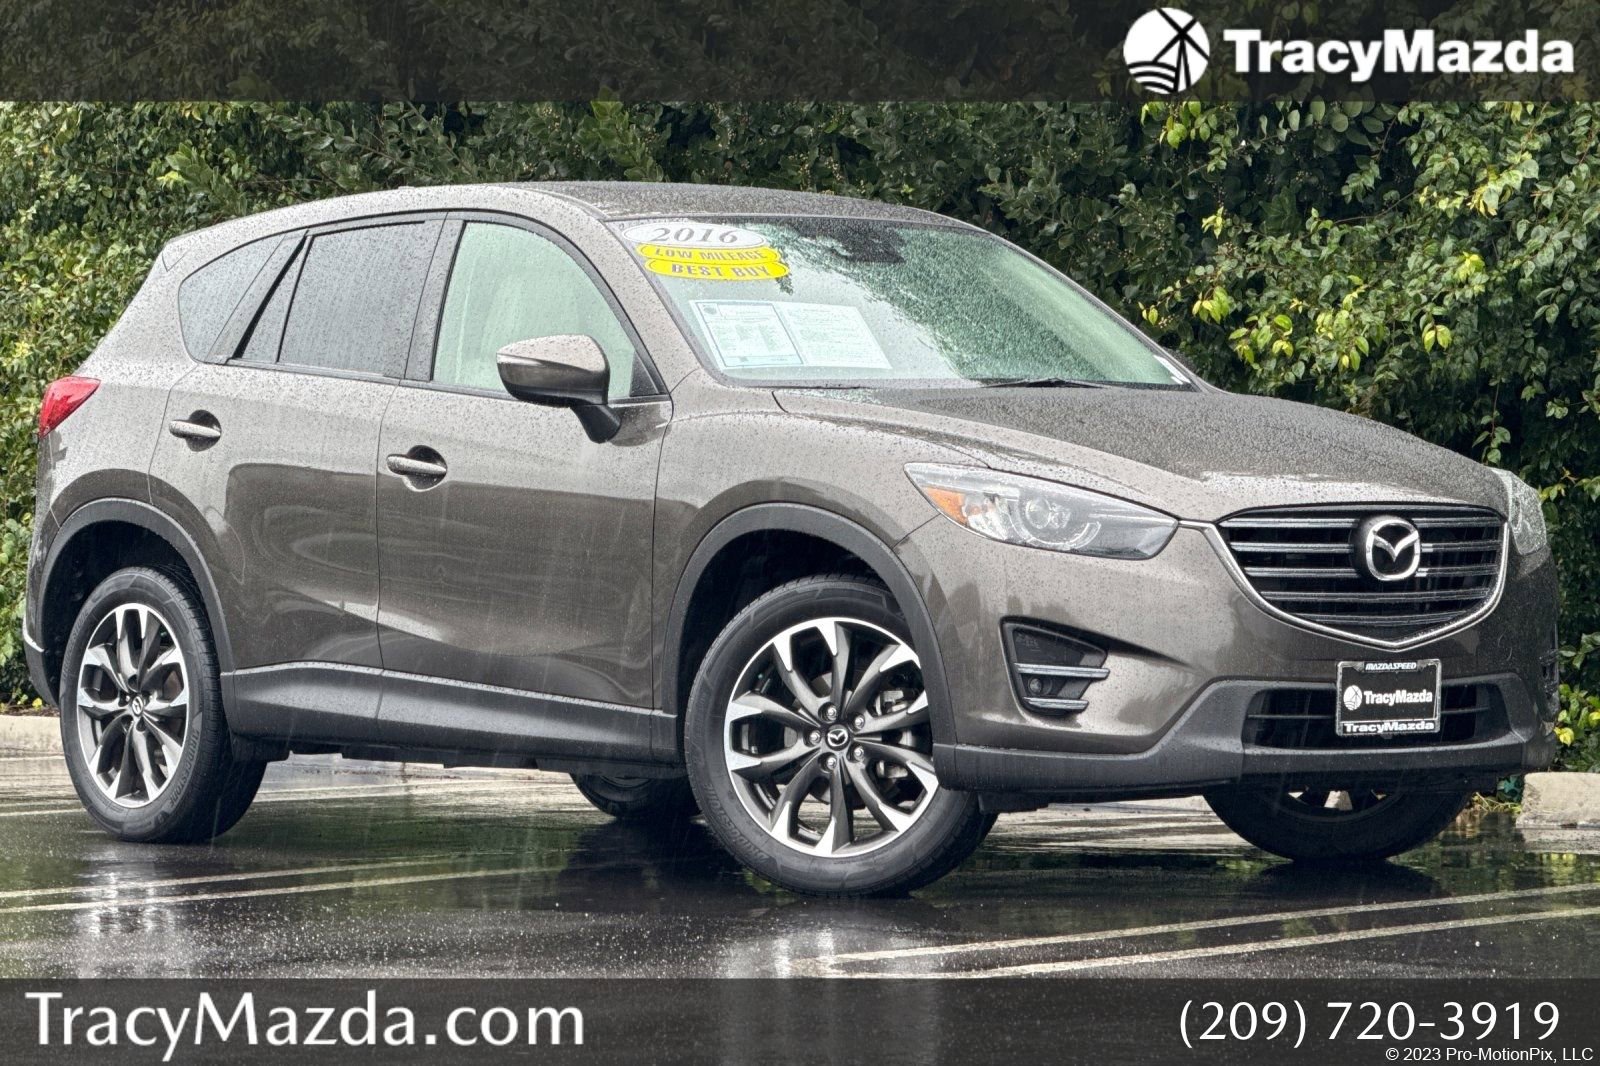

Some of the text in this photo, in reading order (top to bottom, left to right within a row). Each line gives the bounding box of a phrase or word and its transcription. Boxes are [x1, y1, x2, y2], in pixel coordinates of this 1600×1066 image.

[650, 227, 738, 243] 2016
[655, 248, 768, 261] LOW MILEAGE
[671, 263, 770, 277] BEST BUY
[1365, 662, 1417, 670] MAZDASPEED
[1364, 689, 1433, 706] TracyMazda
[1344, 721, 1434, 733] TracyMazda
